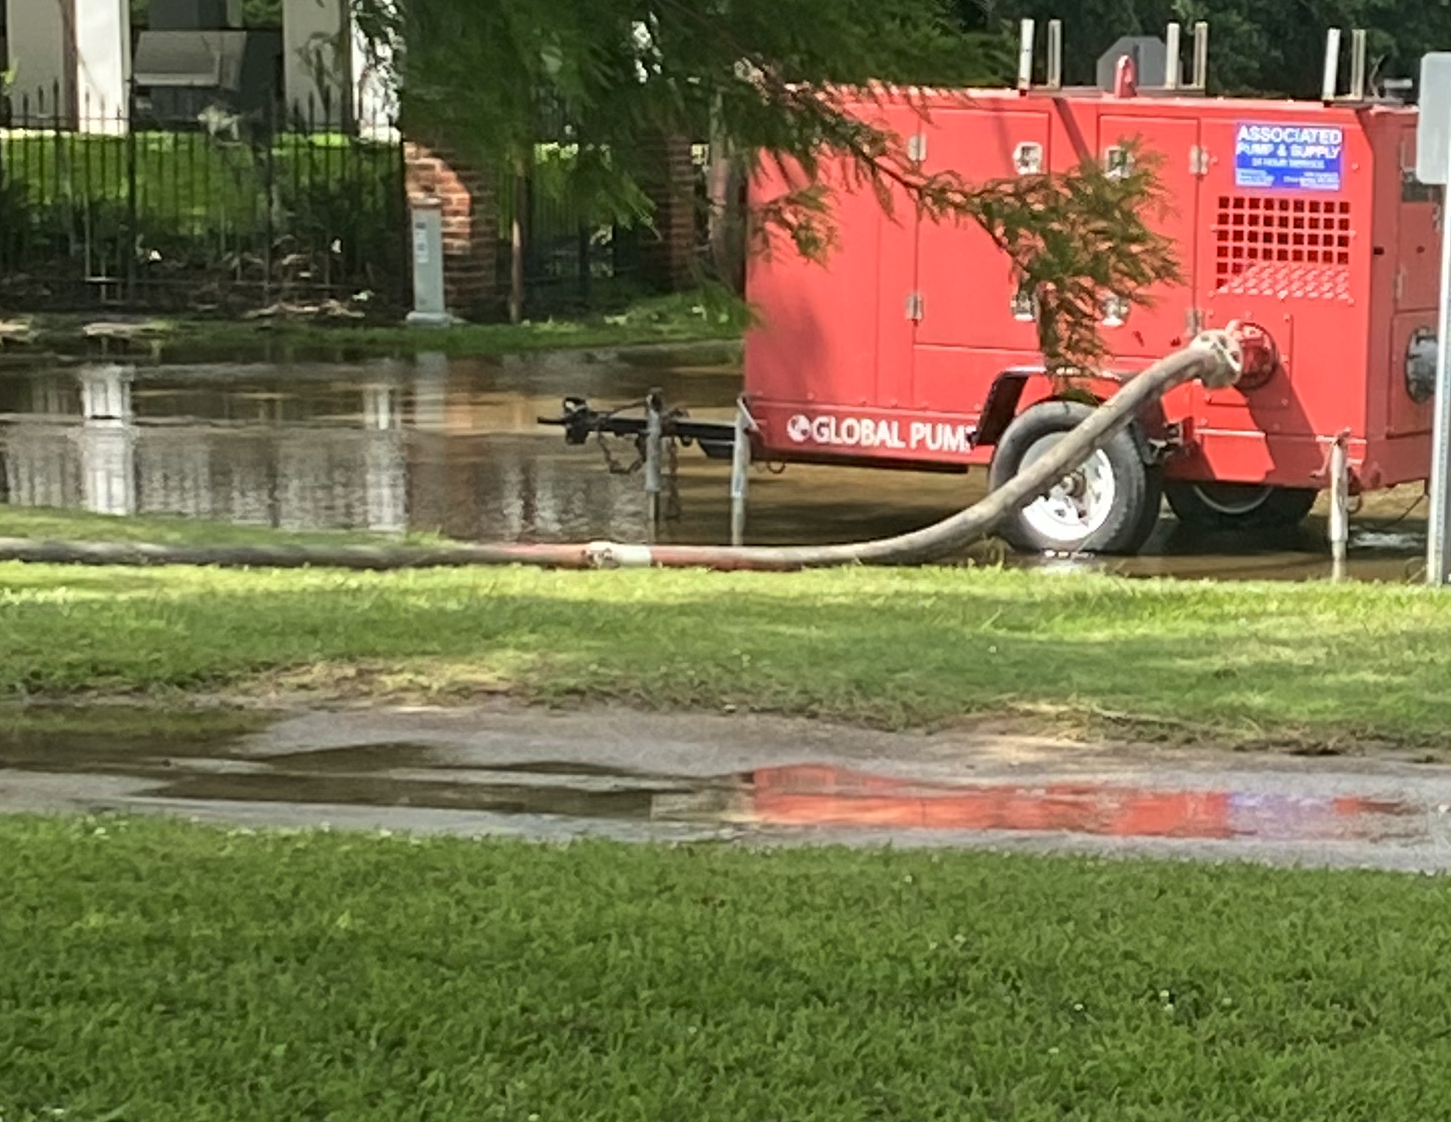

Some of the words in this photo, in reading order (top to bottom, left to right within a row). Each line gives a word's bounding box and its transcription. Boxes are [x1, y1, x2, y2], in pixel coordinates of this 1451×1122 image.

[1239, 125, 1342, 144] ASSOCIATED
[1236, 141, 1274, 156] PUMP
[1277, 143, 1288, 157] &
[1291, 144, 1340, 159] SUPPLY
[811, 415, 905, 448] GLOBAL
